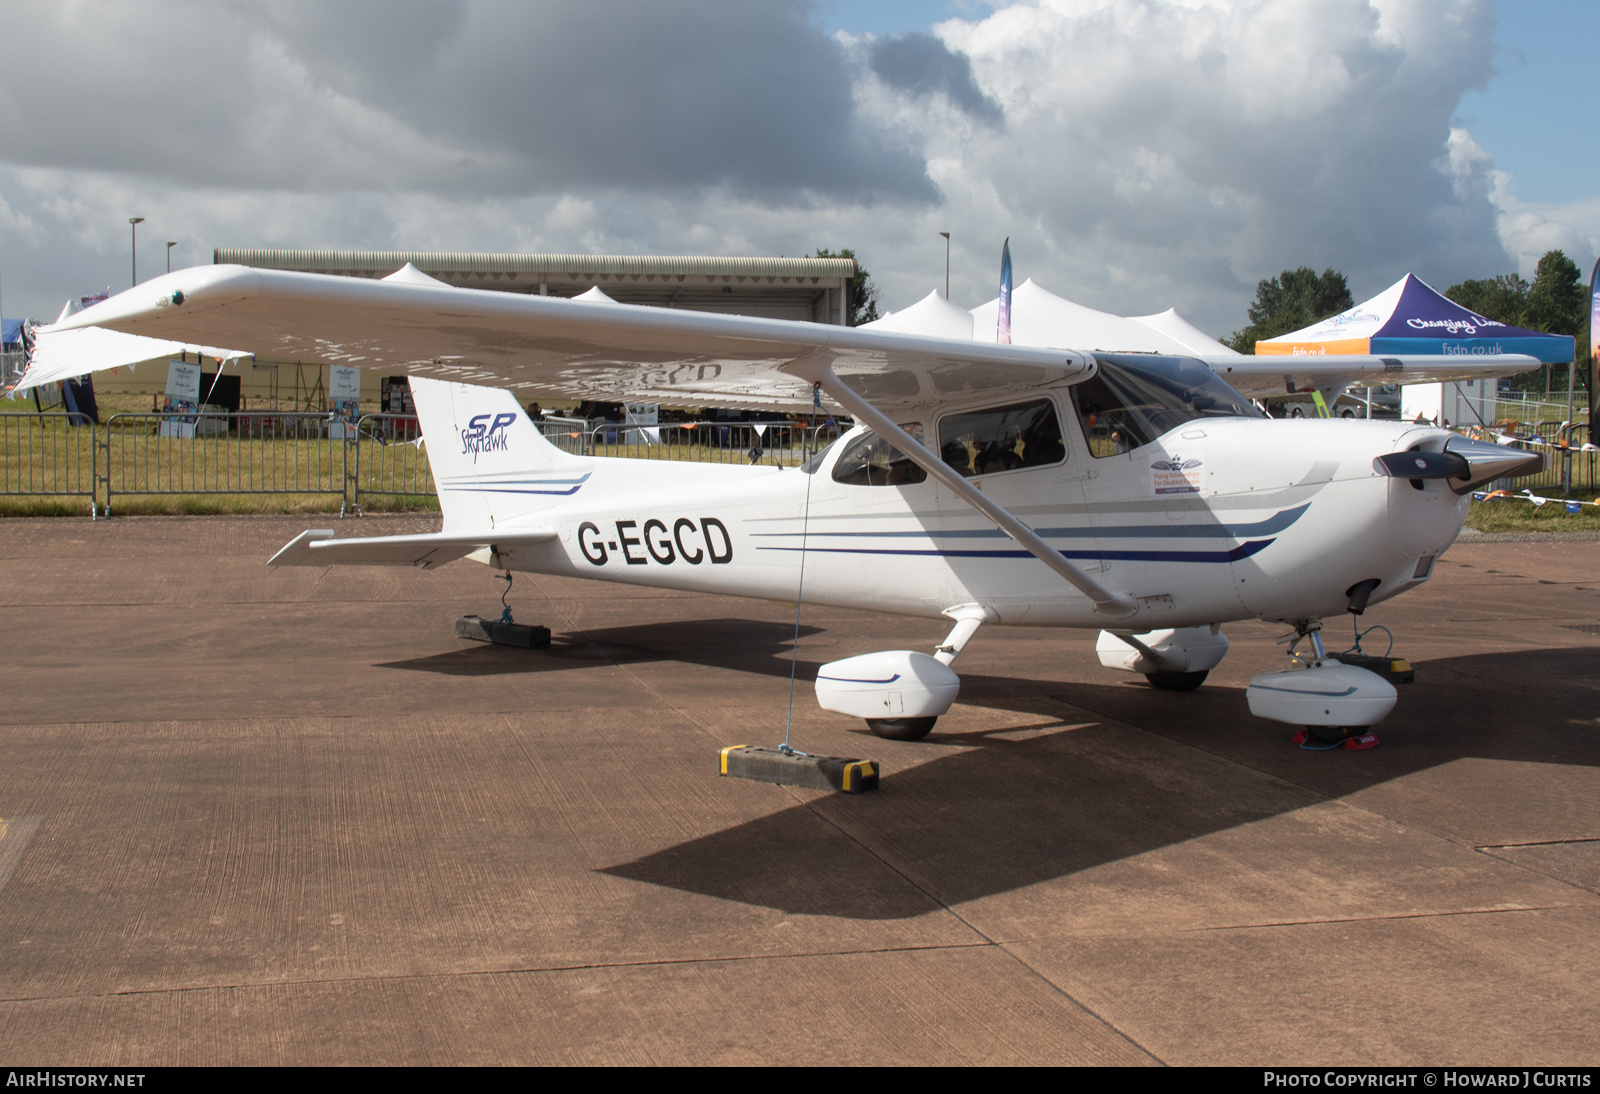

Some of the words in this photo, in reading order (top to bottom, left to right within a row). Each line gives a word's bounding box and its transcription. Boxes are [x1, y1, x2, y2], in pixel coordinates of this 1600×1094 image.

[1407, 317, 1477, 334] Changing
[465, 412, 518, 439] SP
[577, 517, 733, 566] G-EGCD
